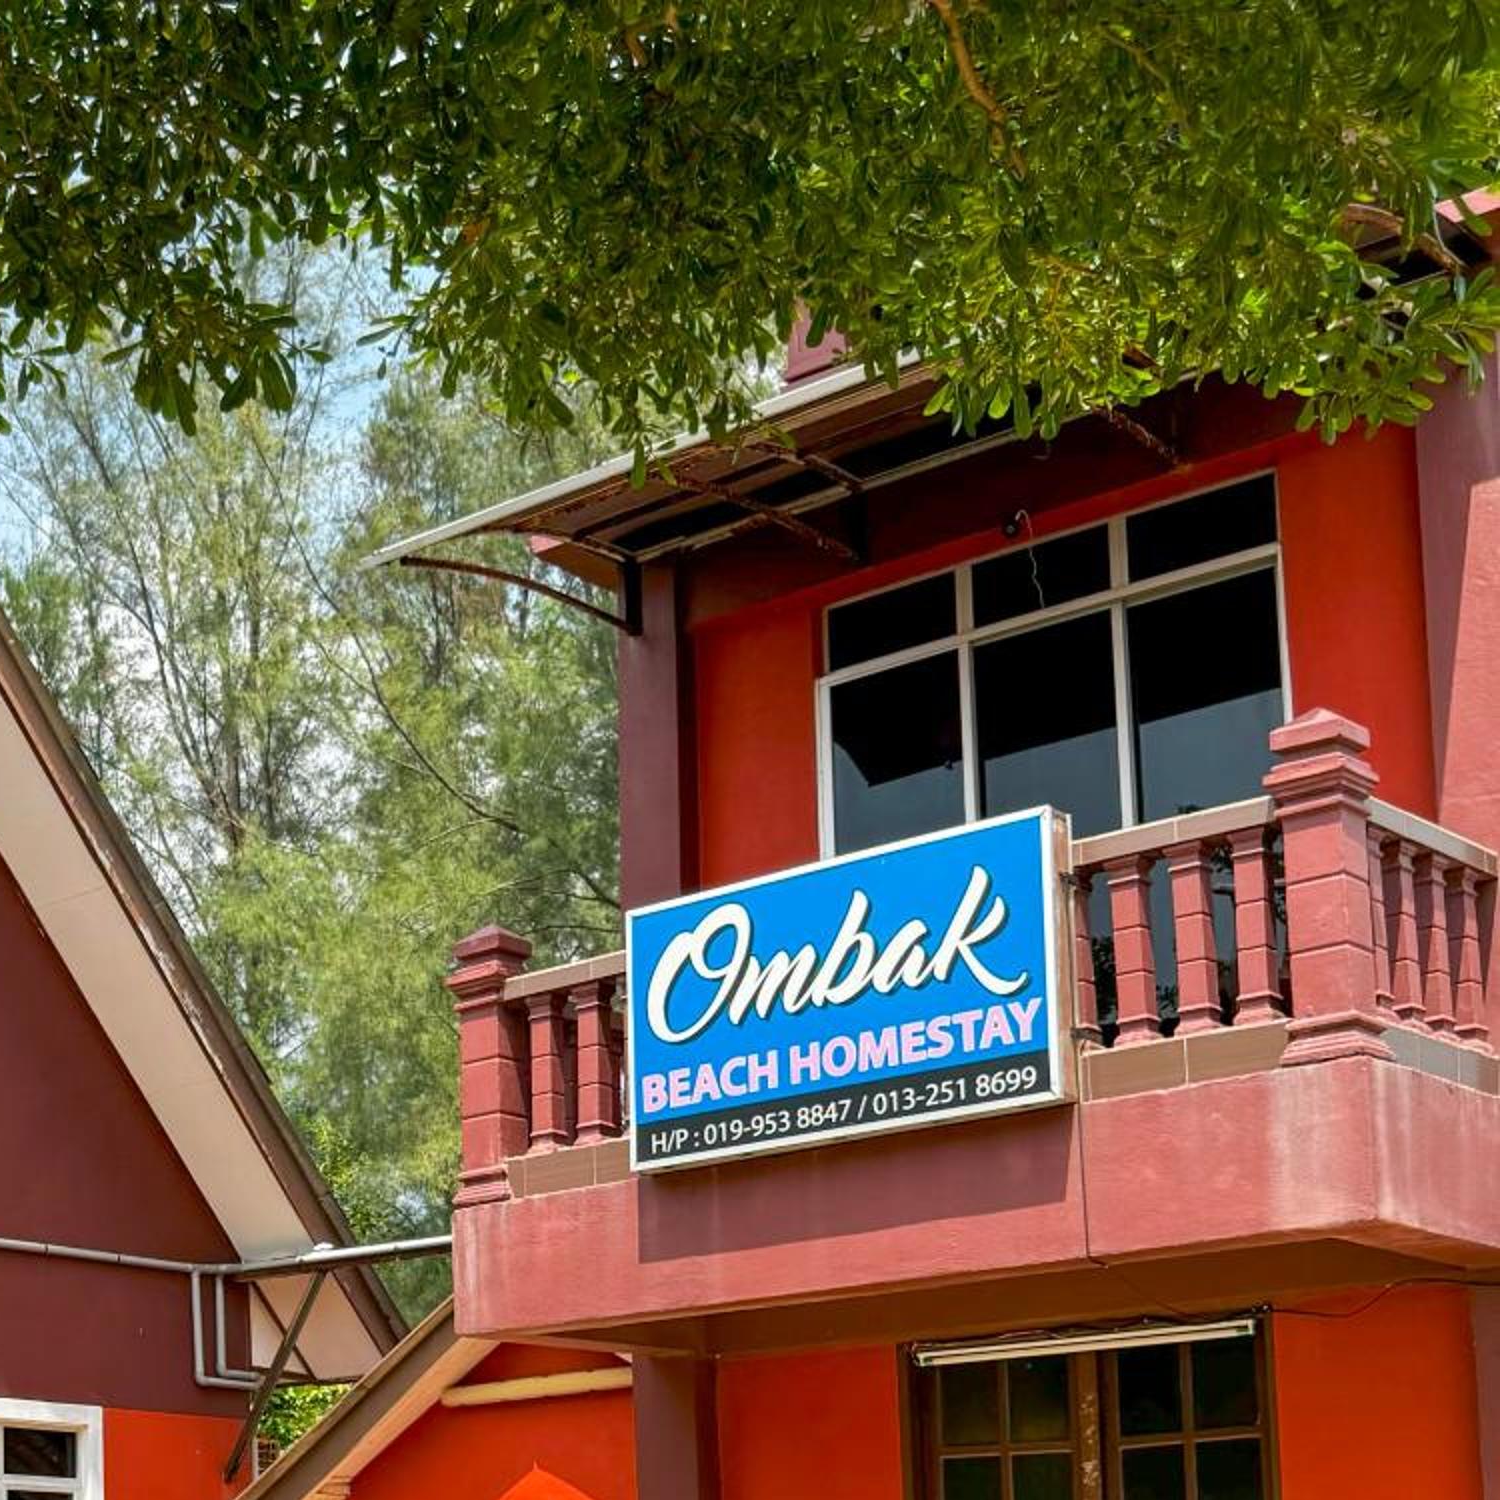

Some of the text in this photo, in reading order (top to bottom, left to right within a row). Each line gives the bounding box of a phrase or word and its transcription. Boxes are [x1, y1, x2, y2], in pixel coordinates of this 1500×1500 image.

[647, 865, 1028, 1043] Ombak
[642, 997, 1041, 1113] BEACH HOMESTAY
[703, 1110, 790, 1144] 019-953
[797, 1100, 851, 1129] 8847
[873, 1078, 966, 1115] 013-251
[975, 1065, 1037, 1097] 8699
